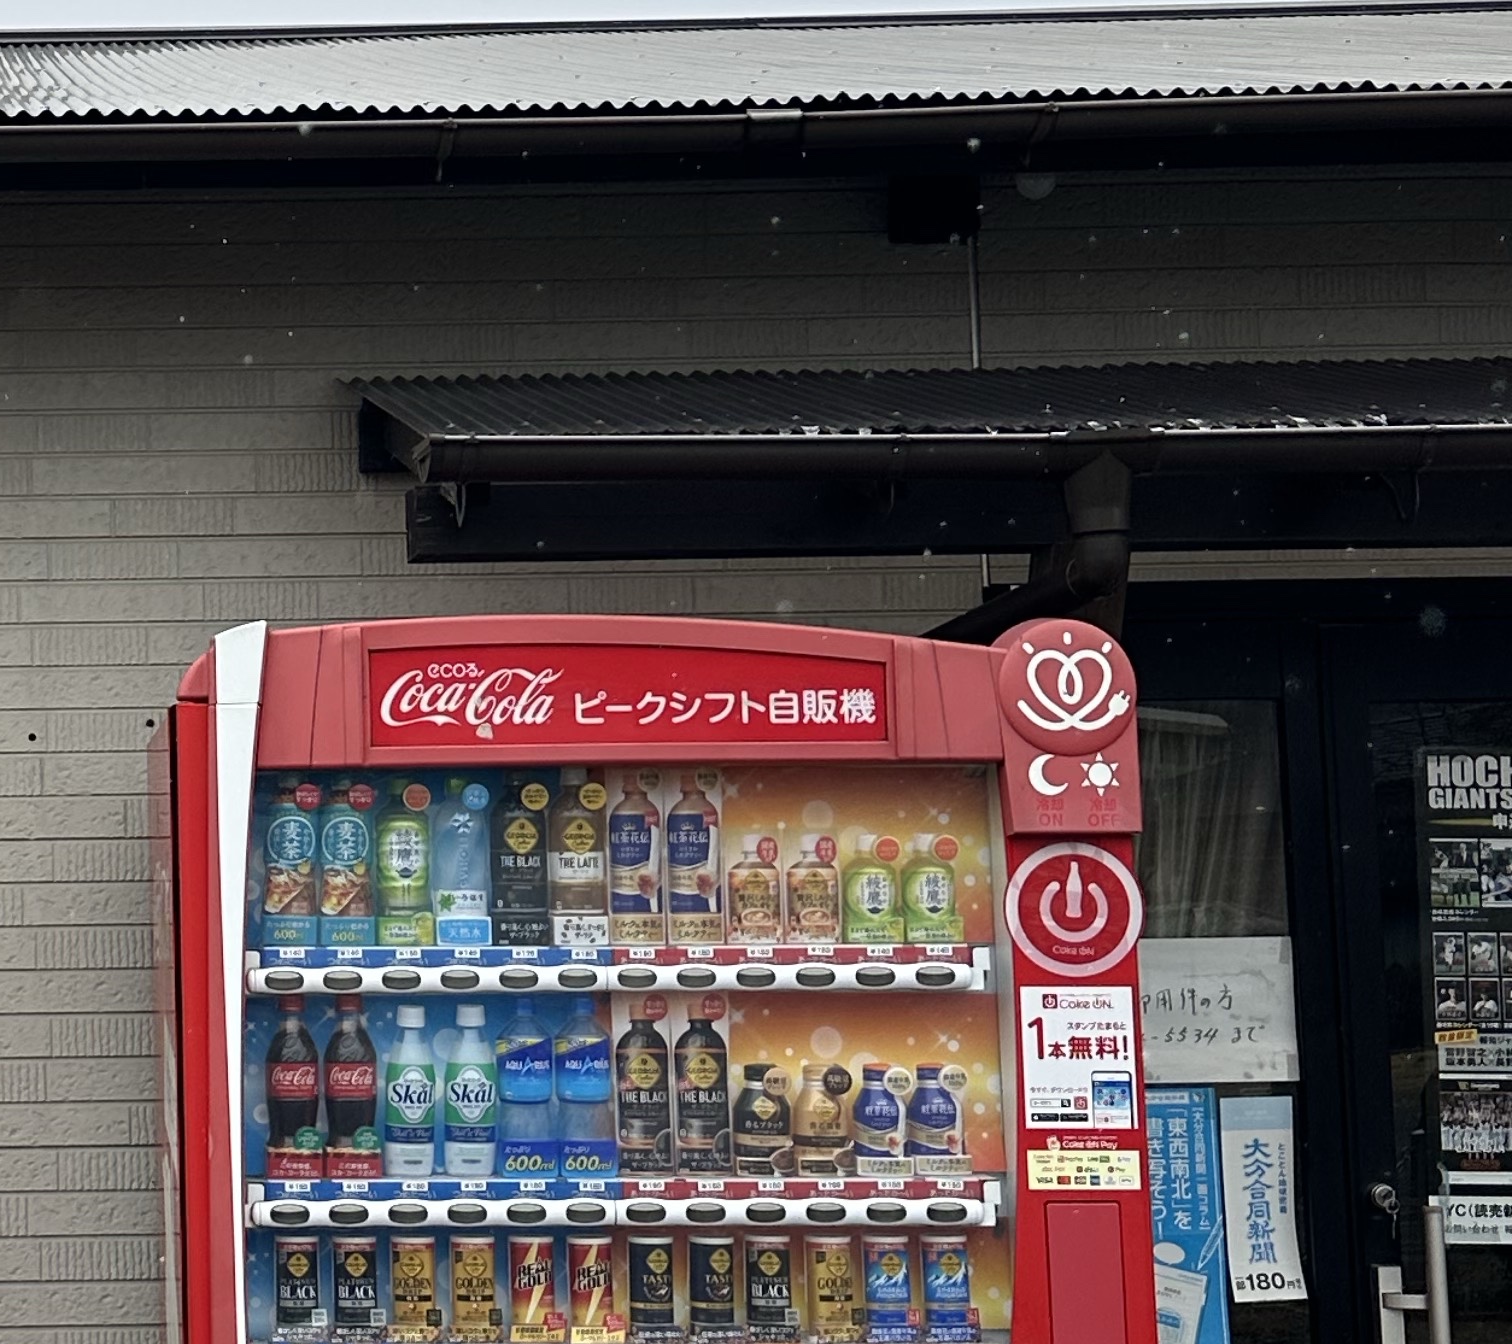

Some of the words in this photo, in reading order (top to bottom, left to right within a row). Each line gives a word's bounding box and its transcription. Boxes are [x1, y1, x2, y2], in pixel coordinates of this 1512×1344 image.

[381, 668, 564, 727] Coca-Cola
[574, 688, 876, 725] ピークシフト自販機
[1428, 788, 1512, 810] GIANTS
[1039, 814, 1063, 826] ON
[1088, 814, 1121, 826] OFF
[281, 821, 302, 860] 麦茶
[335, 821, 357, 861] 麦茶
[500, 855, 515, 867] THE
[559, 857, 575, 869] THE
[448, 927, 482, 939] 天然水
[1052, 945, 1078, 955] Coke
[1079, 945, 1095, 956] ON
[1059, 999, 1090, 1009] Coke
[1028, 1017, 1130, 1061] 1本無料!
[621, 1090, 638, 1103] THE
[680, 1090, 696, 1103] THE
[1100, 1140, 1118, 1150] Pay
[1241, 1138, 1278, 1264] 大分合同新聞
[280, 1285, 317, 1300] BLACK
[338, 1285, 376, 1300] BLACK
[751, 1284, 789, 1298] BLACK
